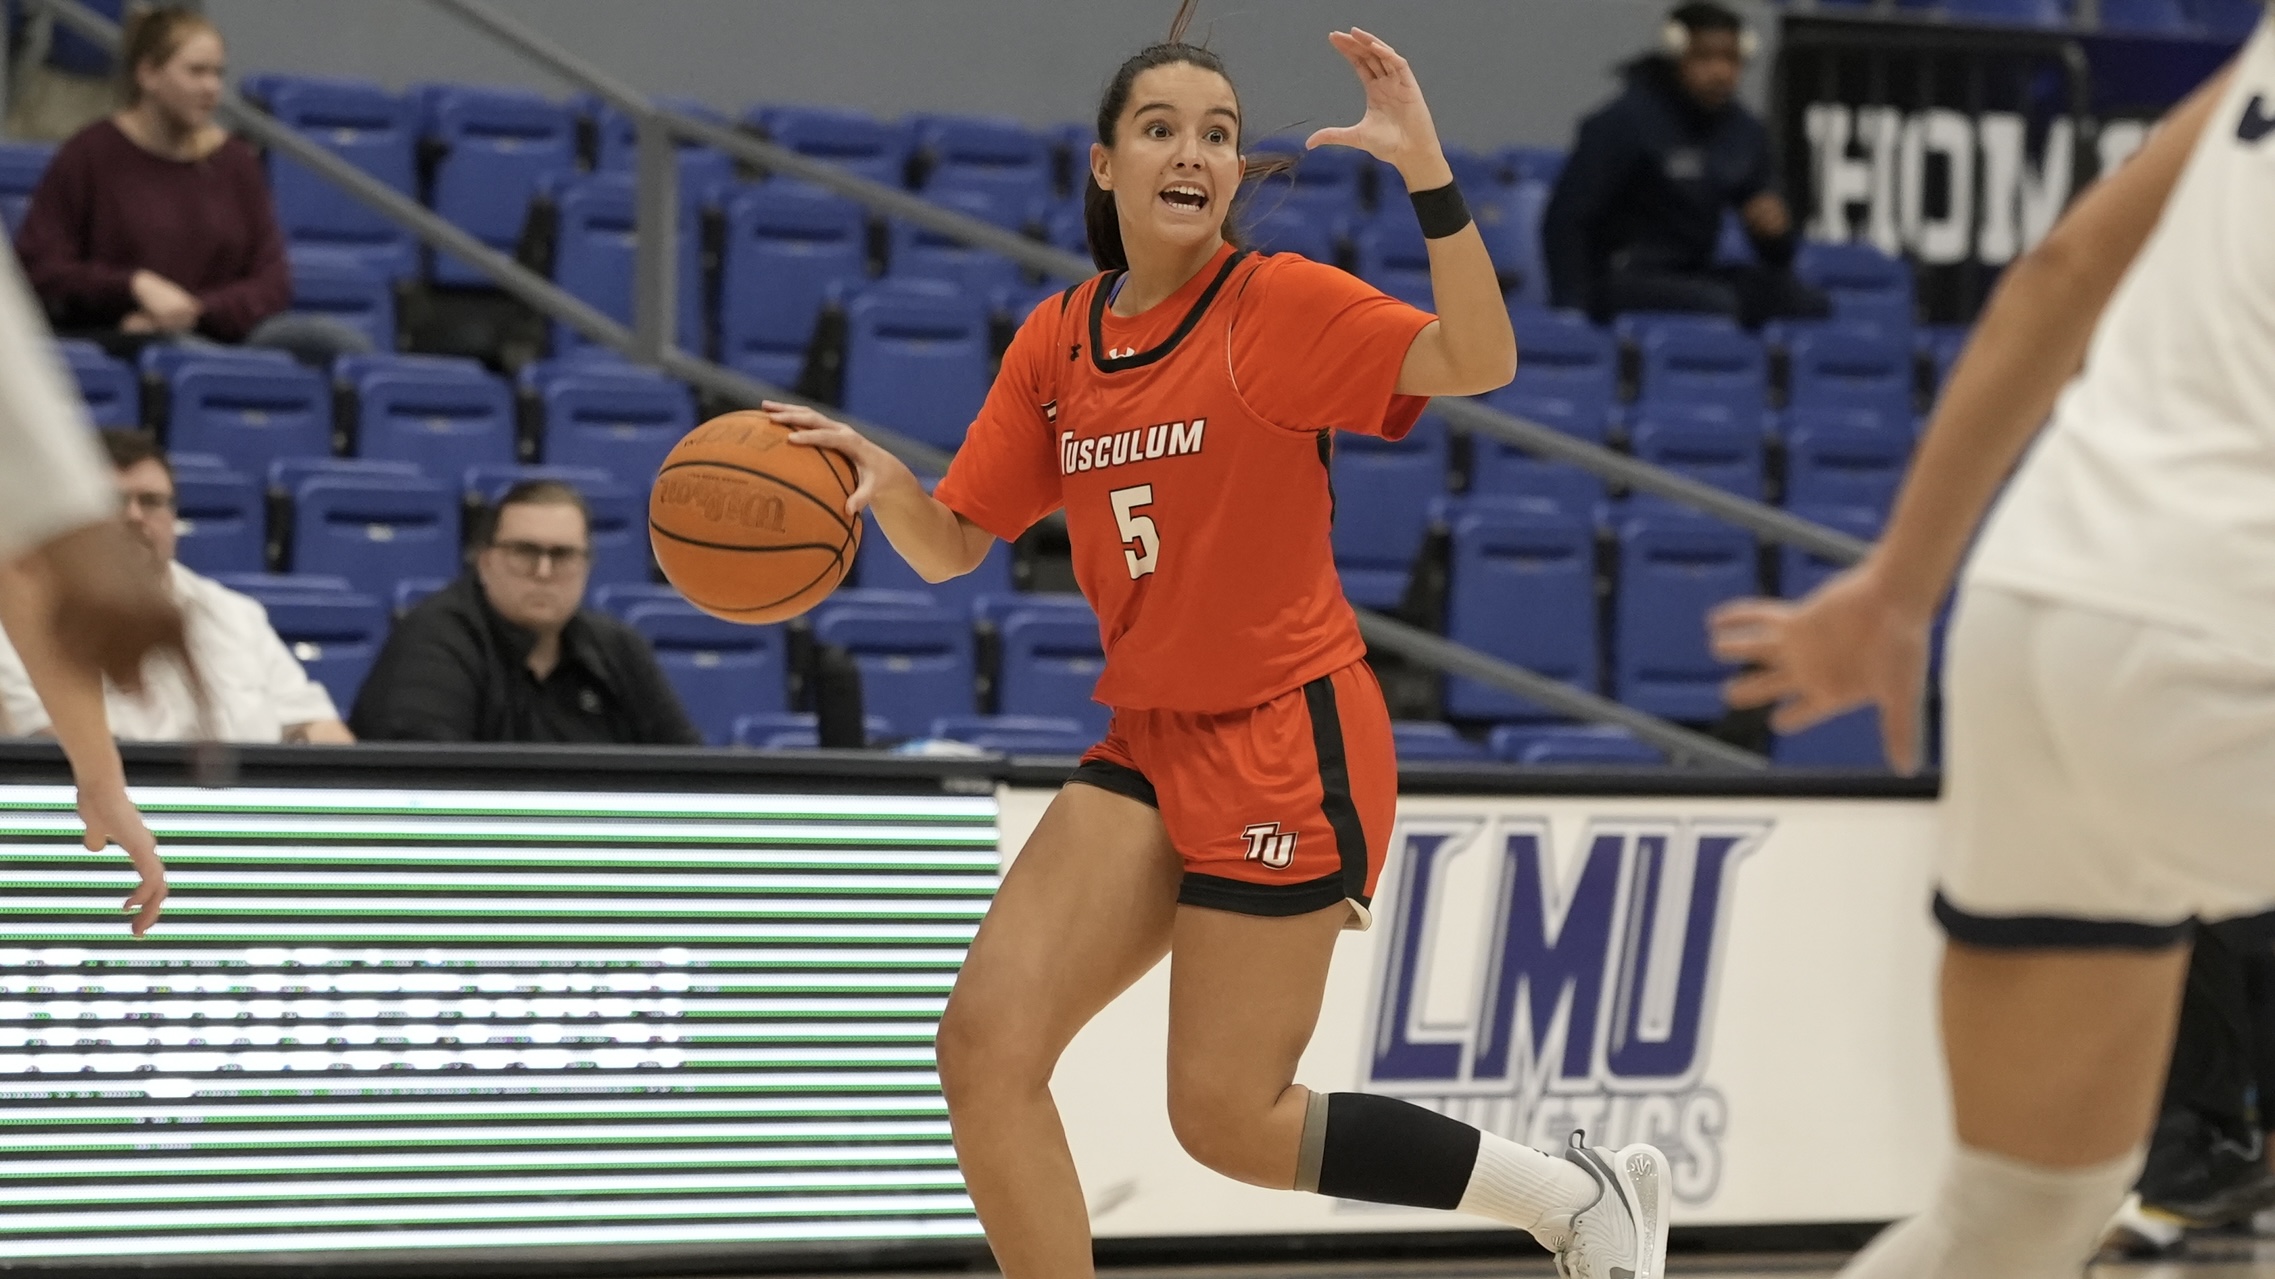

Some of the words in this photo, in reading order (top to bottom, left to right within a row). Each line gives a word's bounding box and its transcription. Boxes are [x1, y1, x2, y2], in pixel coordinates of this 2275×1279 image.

[1804, 104, 2162, 264] HOM
[1060, 417, 1207, 476] TUSCULUM
[1109, 483, 1160, 580] 5
[1241, 821, 1299, 870] TU
[1362, 816, 1775, 1092] LMU
